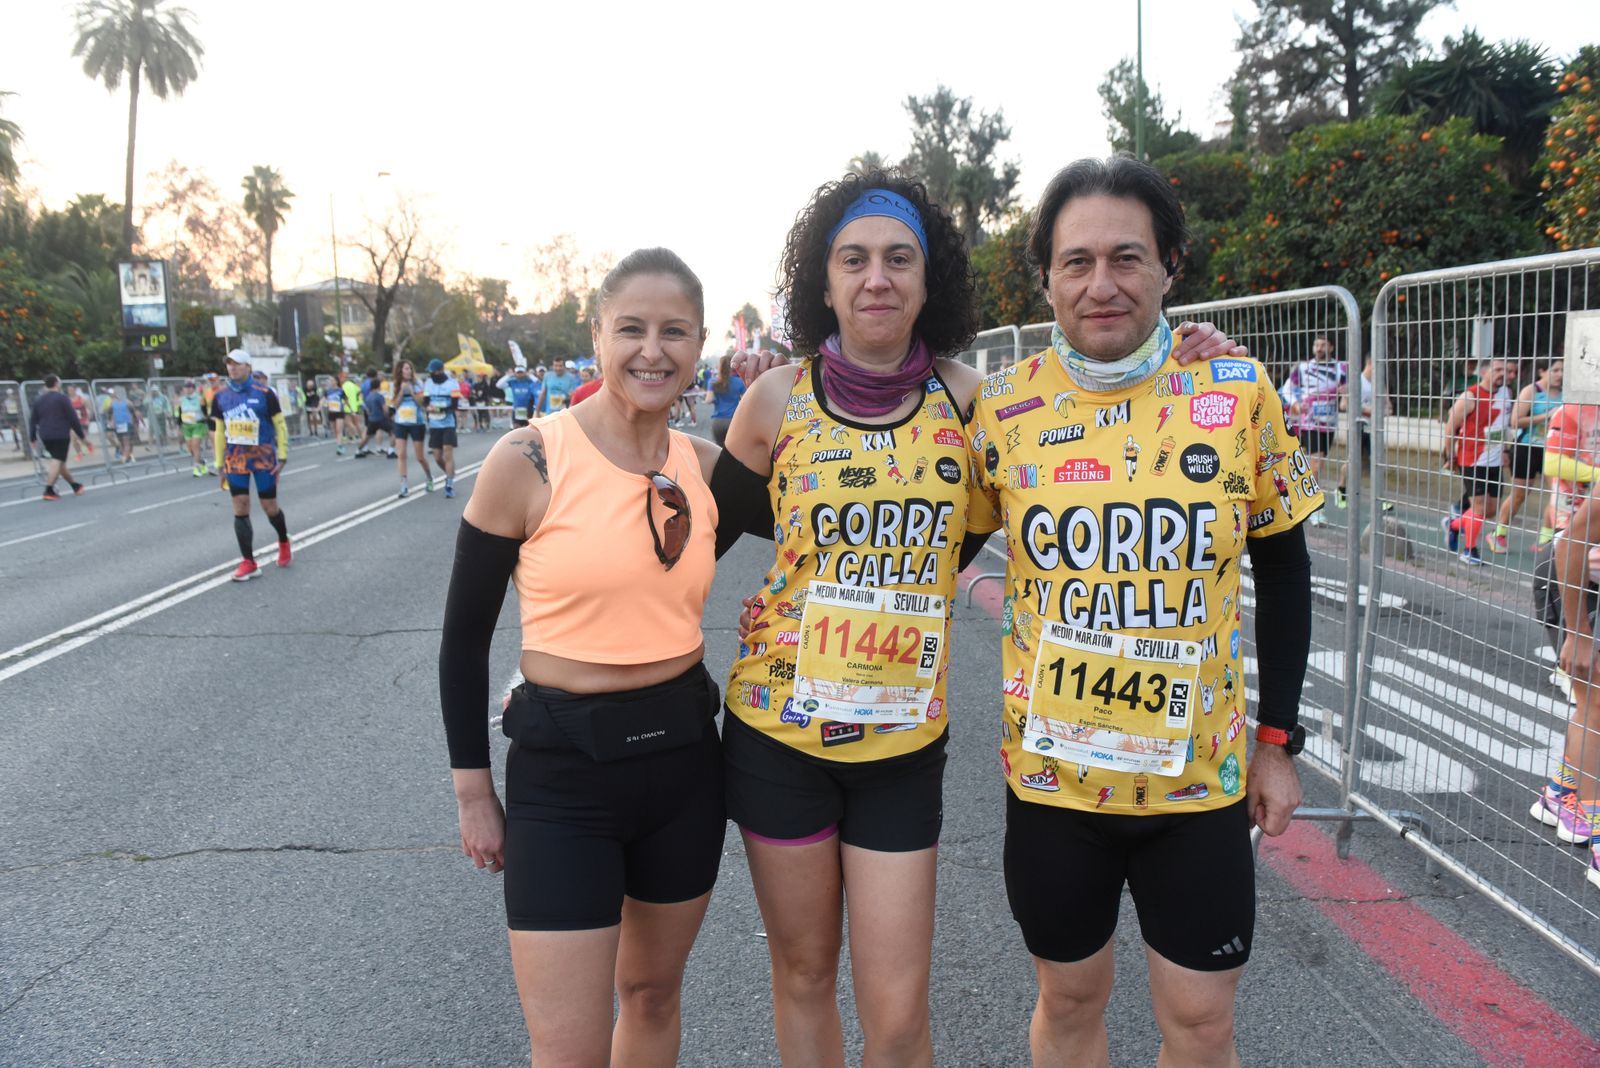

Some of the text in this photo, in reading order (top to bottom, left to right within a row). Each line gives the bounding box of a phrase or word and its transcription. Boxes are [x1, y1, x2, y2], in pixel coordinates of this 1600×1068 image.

[1155, 370, 1195, 398] RUN
[1217, 367, 1250, 380] DAY
[793, 402, 806, 411] TO
[1095, 399, 1131, 428] KM
[860, 430, 896, 452] KM
[1038, 424, 1085, 448] POWER
[811, 448, 852, 464] POWER
[1073, 461, 1088, 471] BE
[1154, 449, 1171, 473] POWER
[838, 465, 876, 480] NEVER
[839, 476, 877, 488] STOP
[1008, 464, 1037, 490] RUN
[1058, 470, 1104, 482] STRONG
[811, 498, 954, 548] CORRE
[1021, 498, 1219, 574] CORRE
[815, 552, 833, 577] Y
[836, 552, 939, 587] CALLA
[815, 585, 930, 613] MEDIO MARATÓN SEVILLA
[1035, 578, 1052, 616] Y
[1059, 577, 1208, 631] CALLA
[814, 616, 922, 665] 11442
[1050, 624, 1073, 641] MEDIO
[1074, 630, 1113, 650] MARATÓN
[1134, 638, 1180, 661] SEVILLA
[846, 662, 883, 672] CARMONA
[740, 680, 770, 711] RUN
[1049, 656, 1168, 714] 11443
[782, 710, 809, 727] Going
[854, 708, 873, 716] HOKA
[1093, 706, 1113, 716] Paco
[625, 729, 666, 743] SALOMON
[1090, 750, 1114, 761] HOKA
[1029, 776, 1048, 785] RUN
